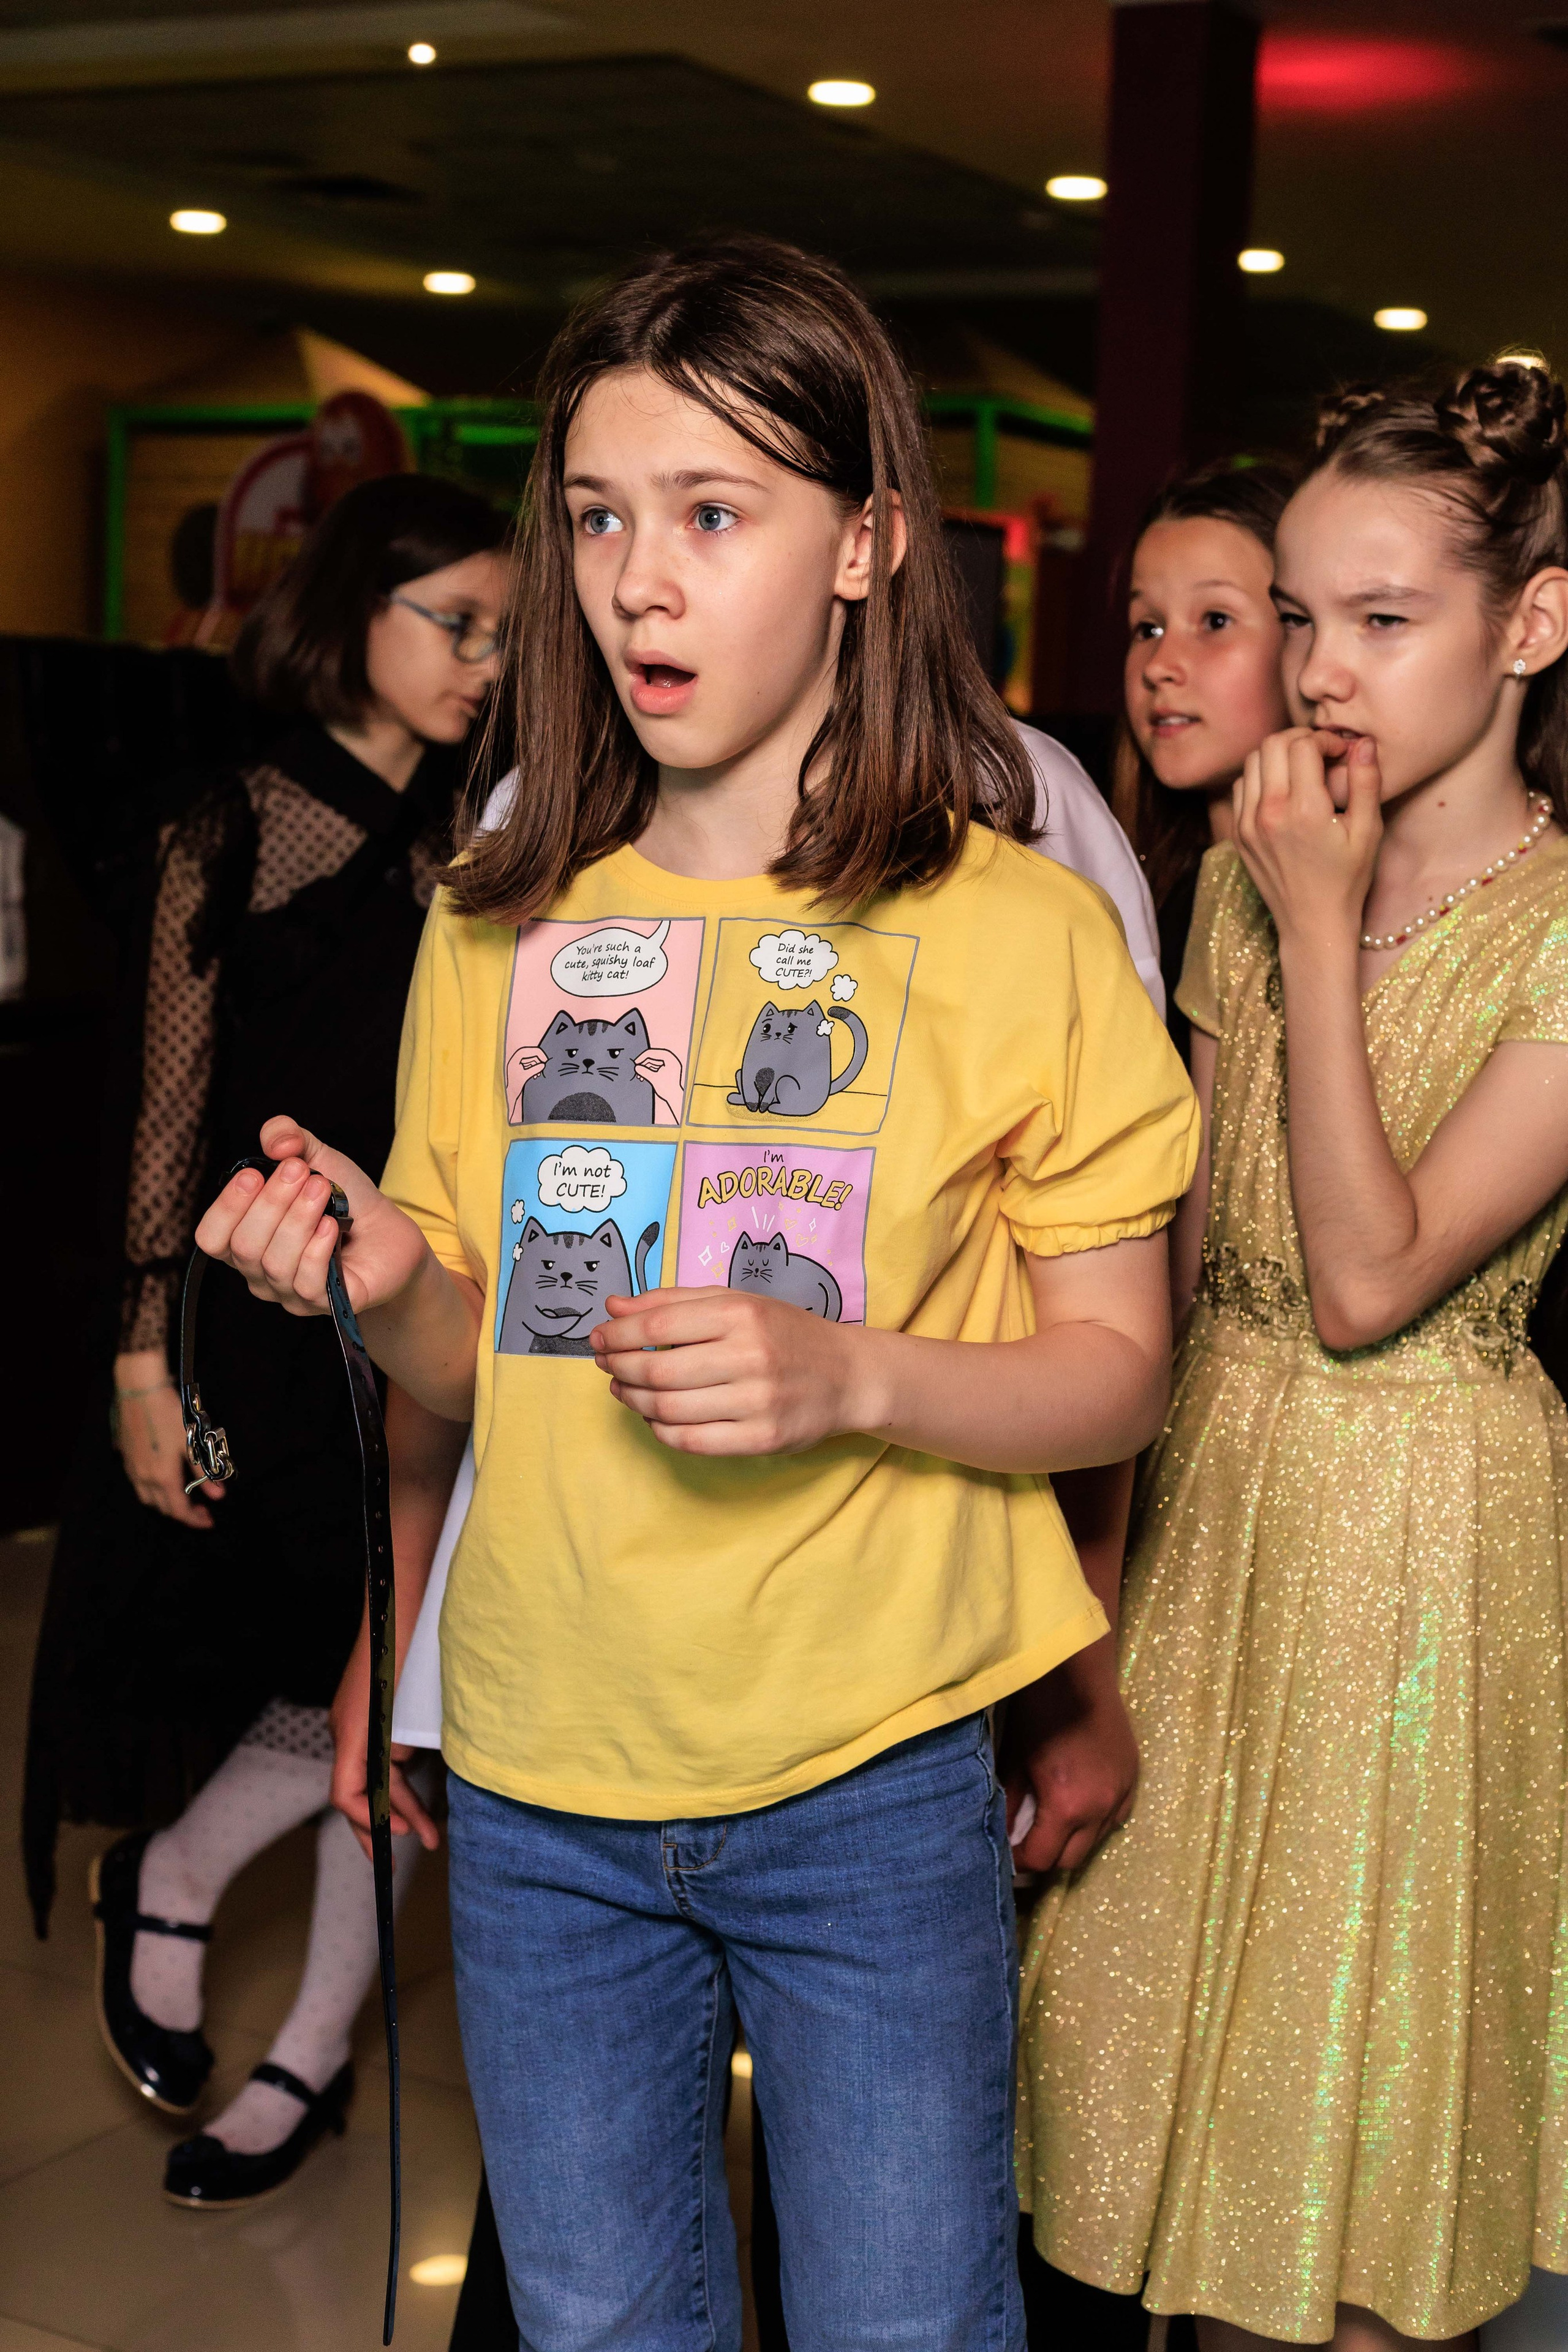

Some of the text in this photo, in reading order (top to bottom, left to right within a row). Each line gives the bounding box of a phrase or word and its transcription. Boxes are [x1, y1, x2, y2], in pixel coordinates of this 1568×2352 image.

[576, 944, 603, 956] You're
[605, 941, 630, 951] such
[778, 943, 814, 954] Did she
[564, 954, 656, 970] cute, squishy loaf
[776, 956, 794, 965] call
[581, 970, 629, 982] kitty cat!
[775, 968, 812, 978] CUTE?!
[763, 1150, 784, 1163] I'm
[554, 1161, 612, 1178] I'm not
[556, 1183, 606, 1198] CUTE!
[697, 1166, 853, 1211] ADORABLE!
